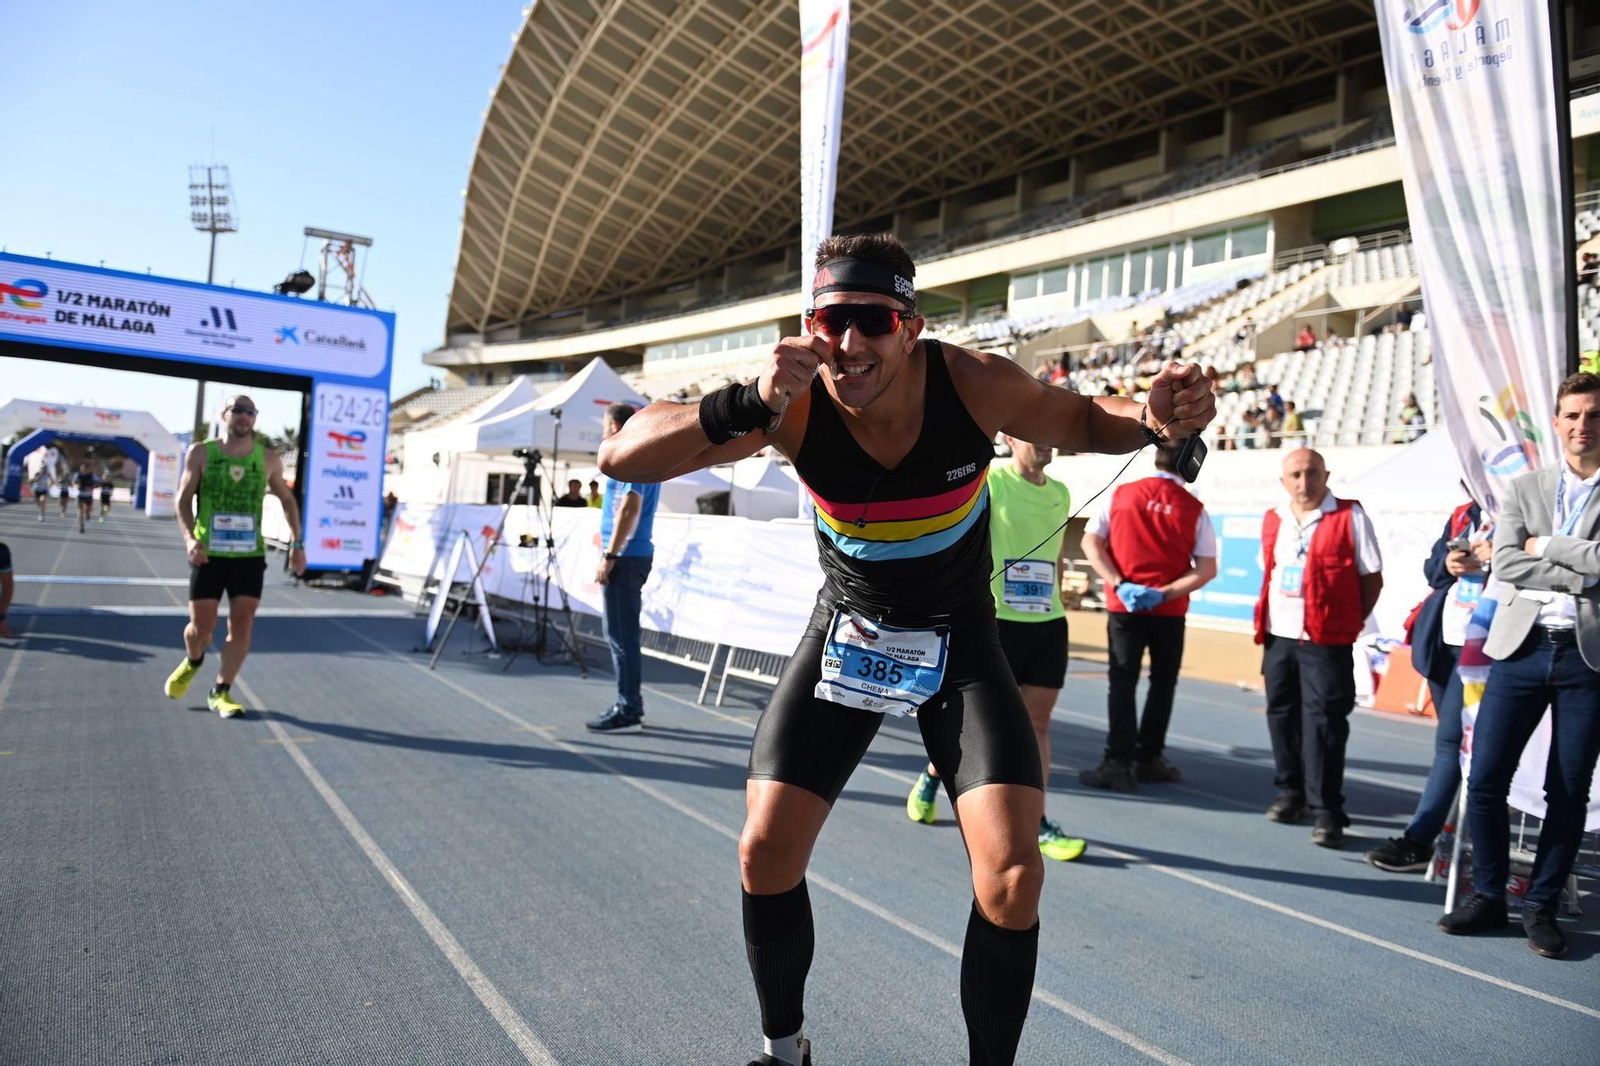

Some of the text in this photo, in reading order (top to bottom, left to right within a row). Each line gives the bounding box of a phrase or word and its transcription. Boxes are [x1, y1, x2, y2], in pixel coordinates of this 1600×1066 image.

[56, 290, 171, 318] 1/2 MARATÓN
[55, 310, 156, 334] DE MÁLAGA
[1022, 584, 1044, 596] 391
[896, 647, 926, 656] MARATÓN
[857, 656, 904, 685] 385
[861, 682, 889, 695] CHEMA
